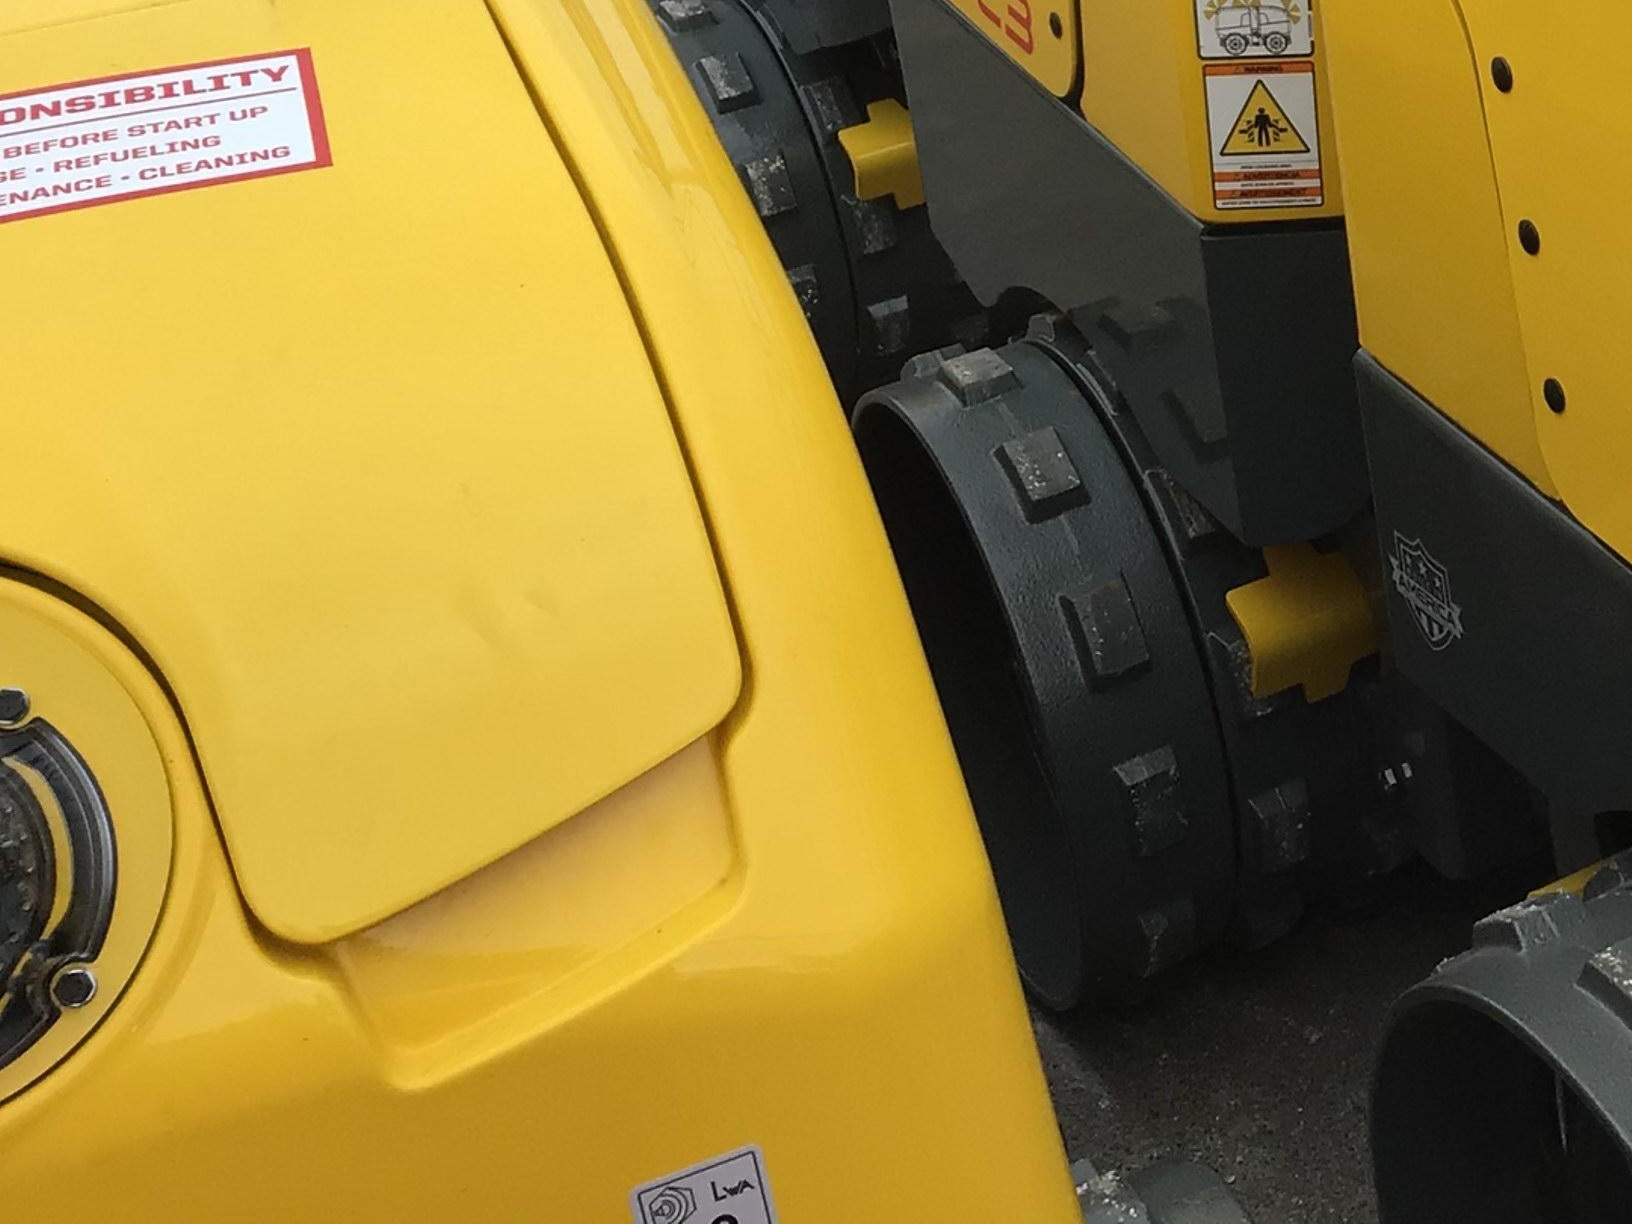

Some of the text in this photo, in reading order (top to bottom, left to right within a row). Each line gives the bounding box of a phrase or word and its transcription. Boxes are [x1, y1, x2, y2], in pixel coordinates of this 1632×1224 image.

[0, 64, 289, 128] ONSIBILITY
[3, 105, 269, 160] BEFORE START UP
[53, 134, 222, 174] REFUELING
[138, 145, 291, 182] CLEANING
